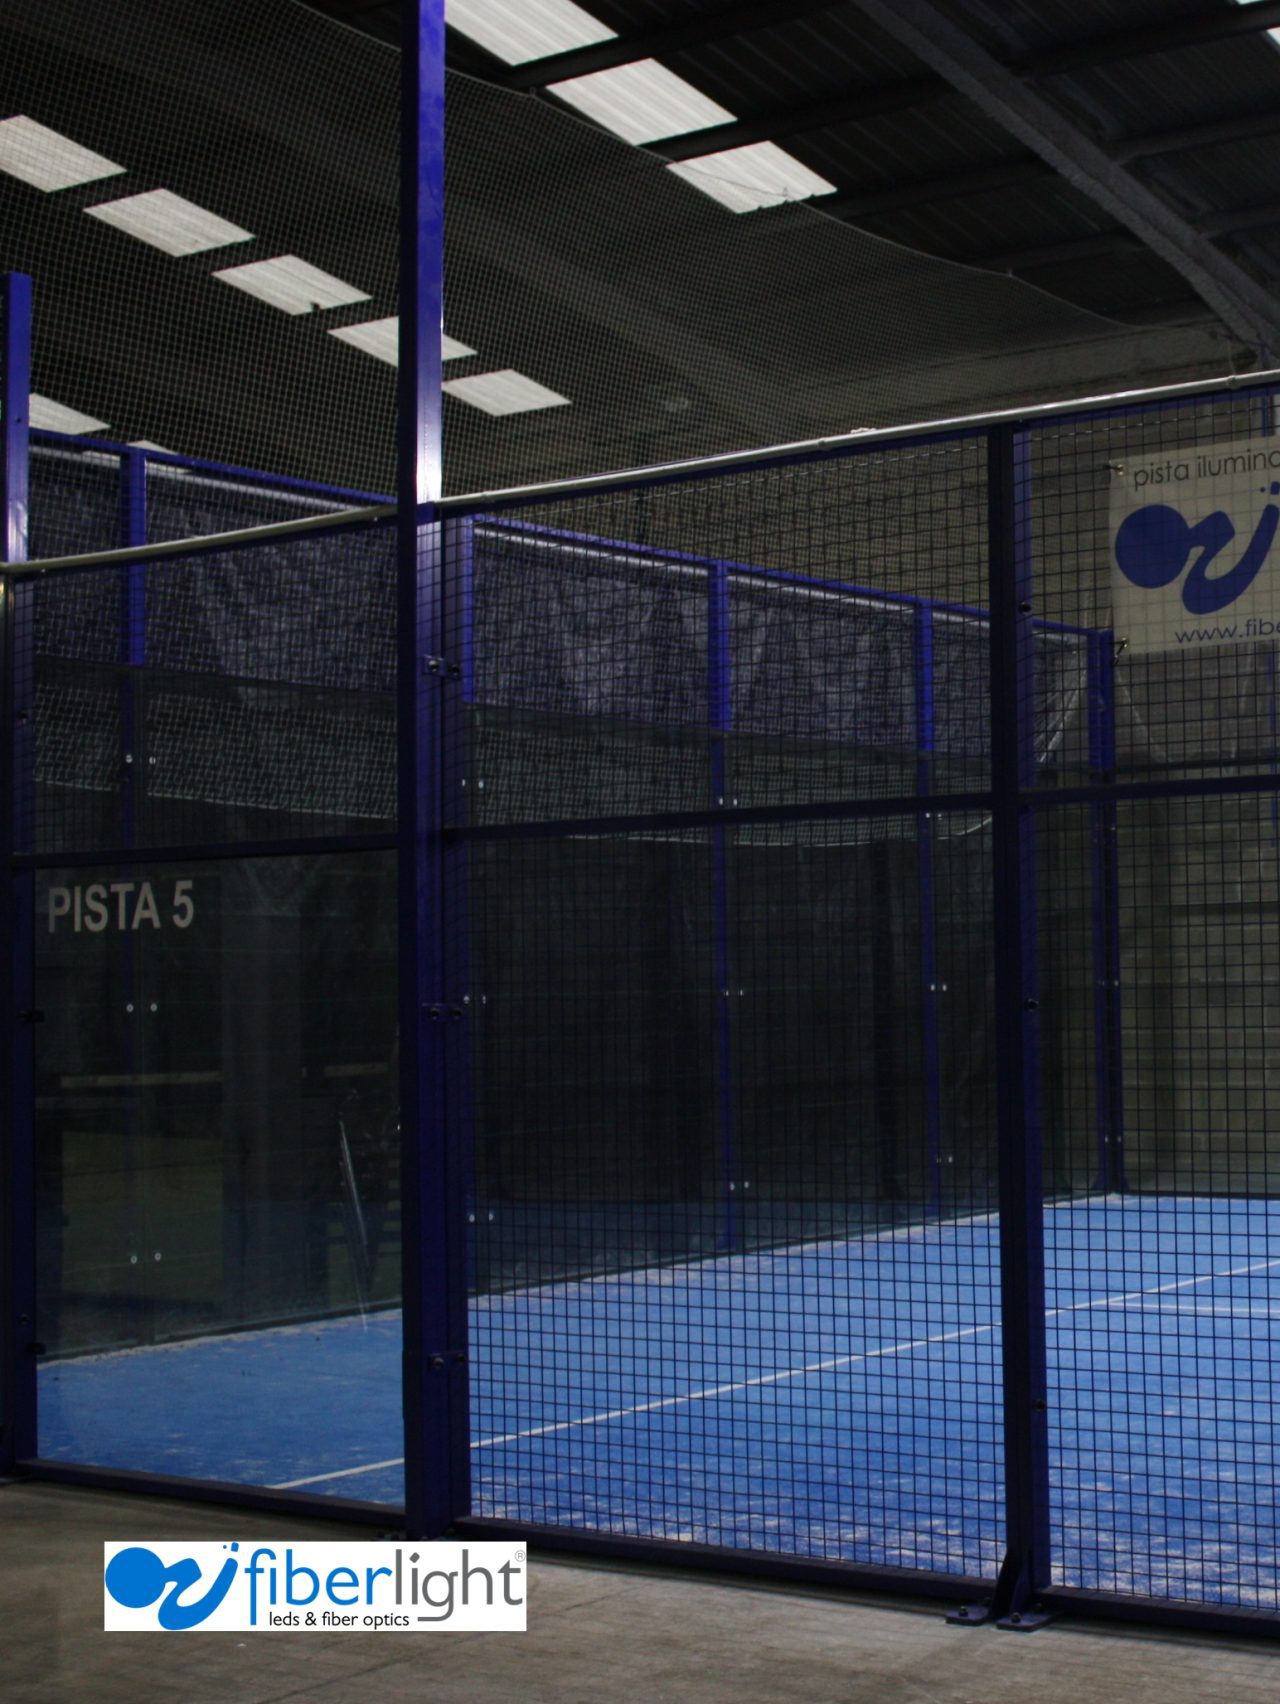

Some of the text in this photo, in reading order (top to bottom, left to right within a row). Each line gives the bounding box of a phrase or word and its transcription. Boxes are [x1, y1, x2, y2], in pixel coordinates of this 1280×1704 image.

[1133, 462, 1189, 491] pista
[48, 880, 194, 934] PISTA 5
